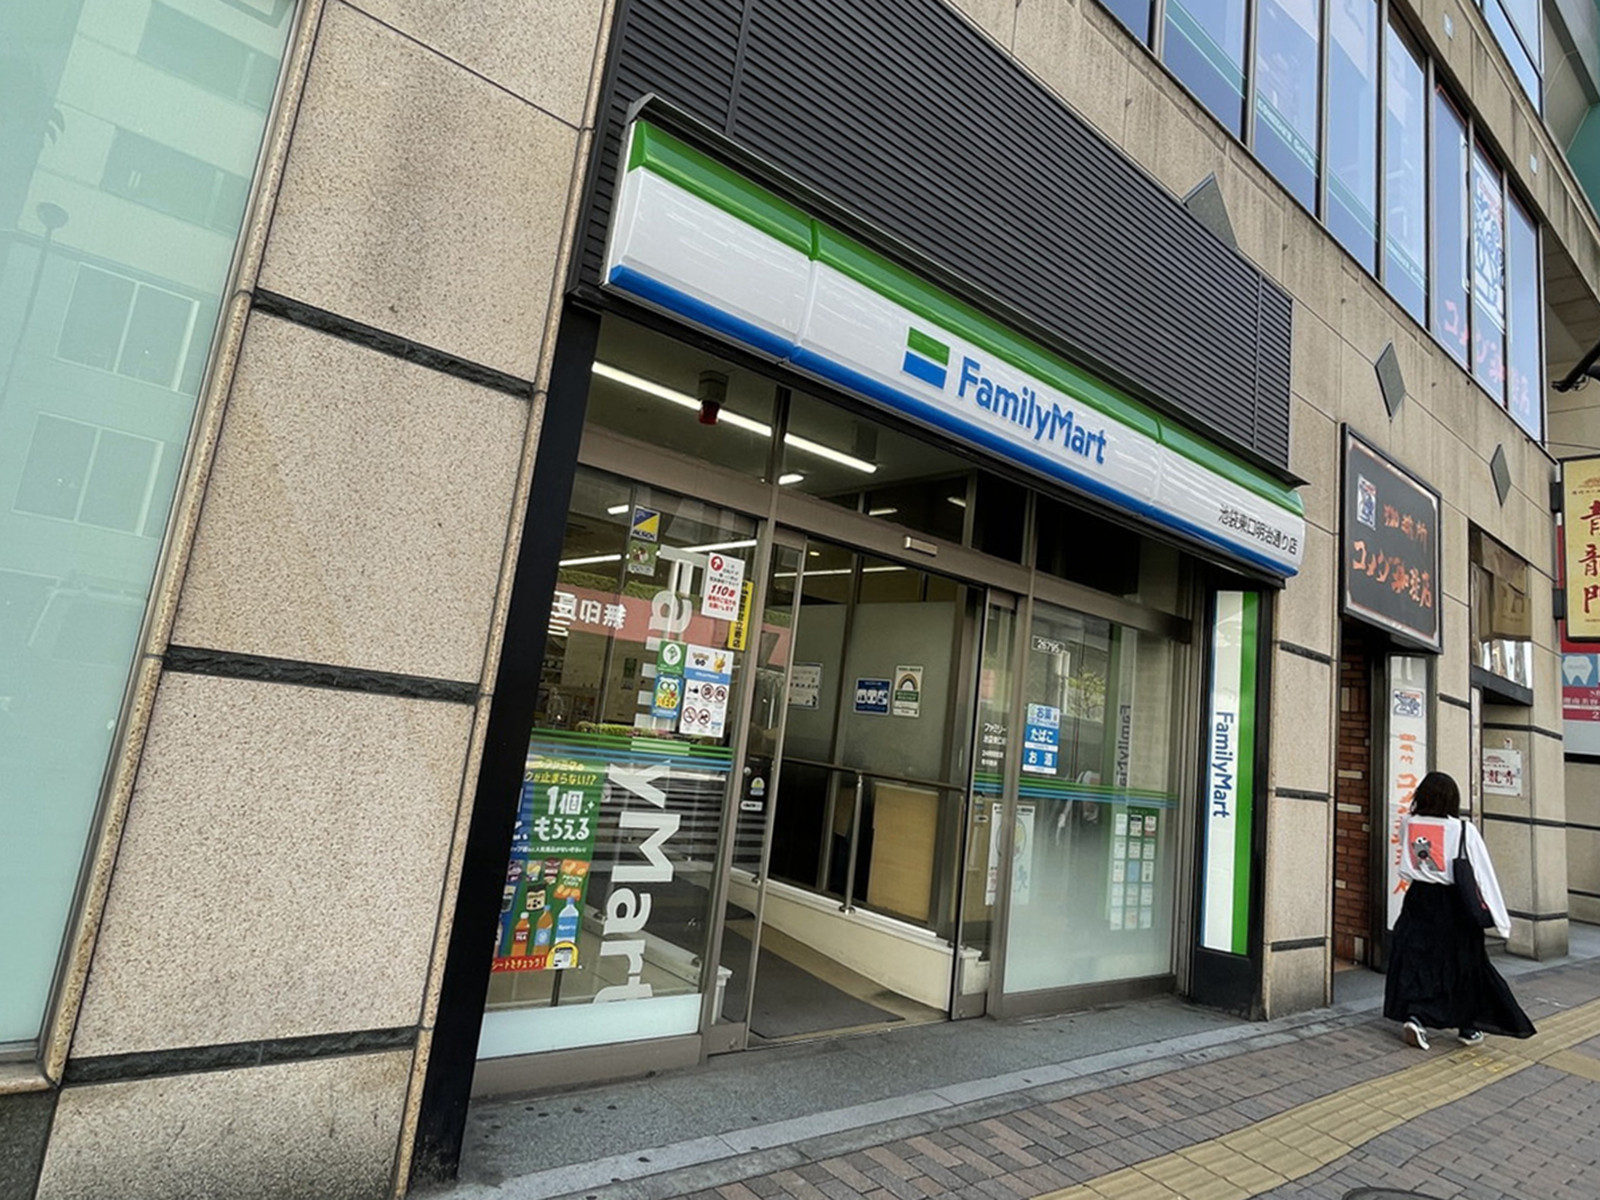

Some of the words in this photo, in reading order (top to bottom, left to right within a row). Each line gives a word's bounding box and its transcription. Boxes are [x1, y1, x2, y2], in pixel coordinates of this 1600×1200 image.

[958, 355, 1107, 465] FamilyMart
[1030, 728, 1055, 744] たばこ
[1212, 711, 1235, 819] FamilyMart
[546, 785, 584, 816] 1個
[533, 816, 591, 842] もらえる
